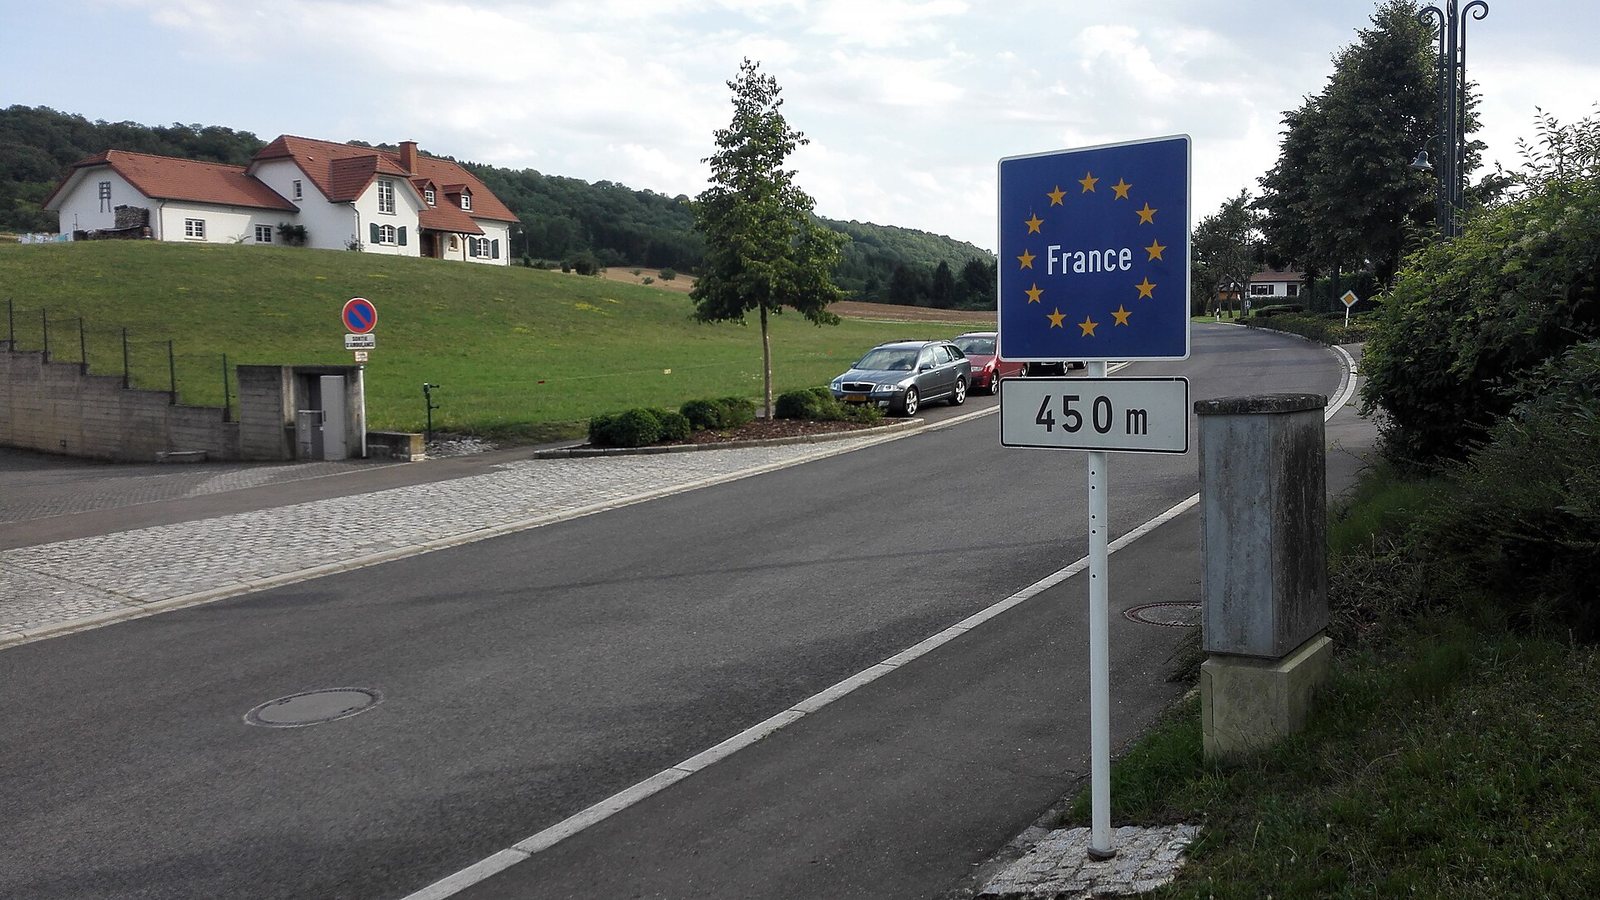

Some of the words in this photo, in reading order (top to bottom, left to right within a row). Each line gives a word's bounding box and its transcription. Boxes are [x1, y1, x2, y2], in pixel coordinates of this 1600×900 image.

[1047, 244, 1132, 275] France
[1035, 395, 1113, 434] 450
[1126, 408, 1148, 435] m
